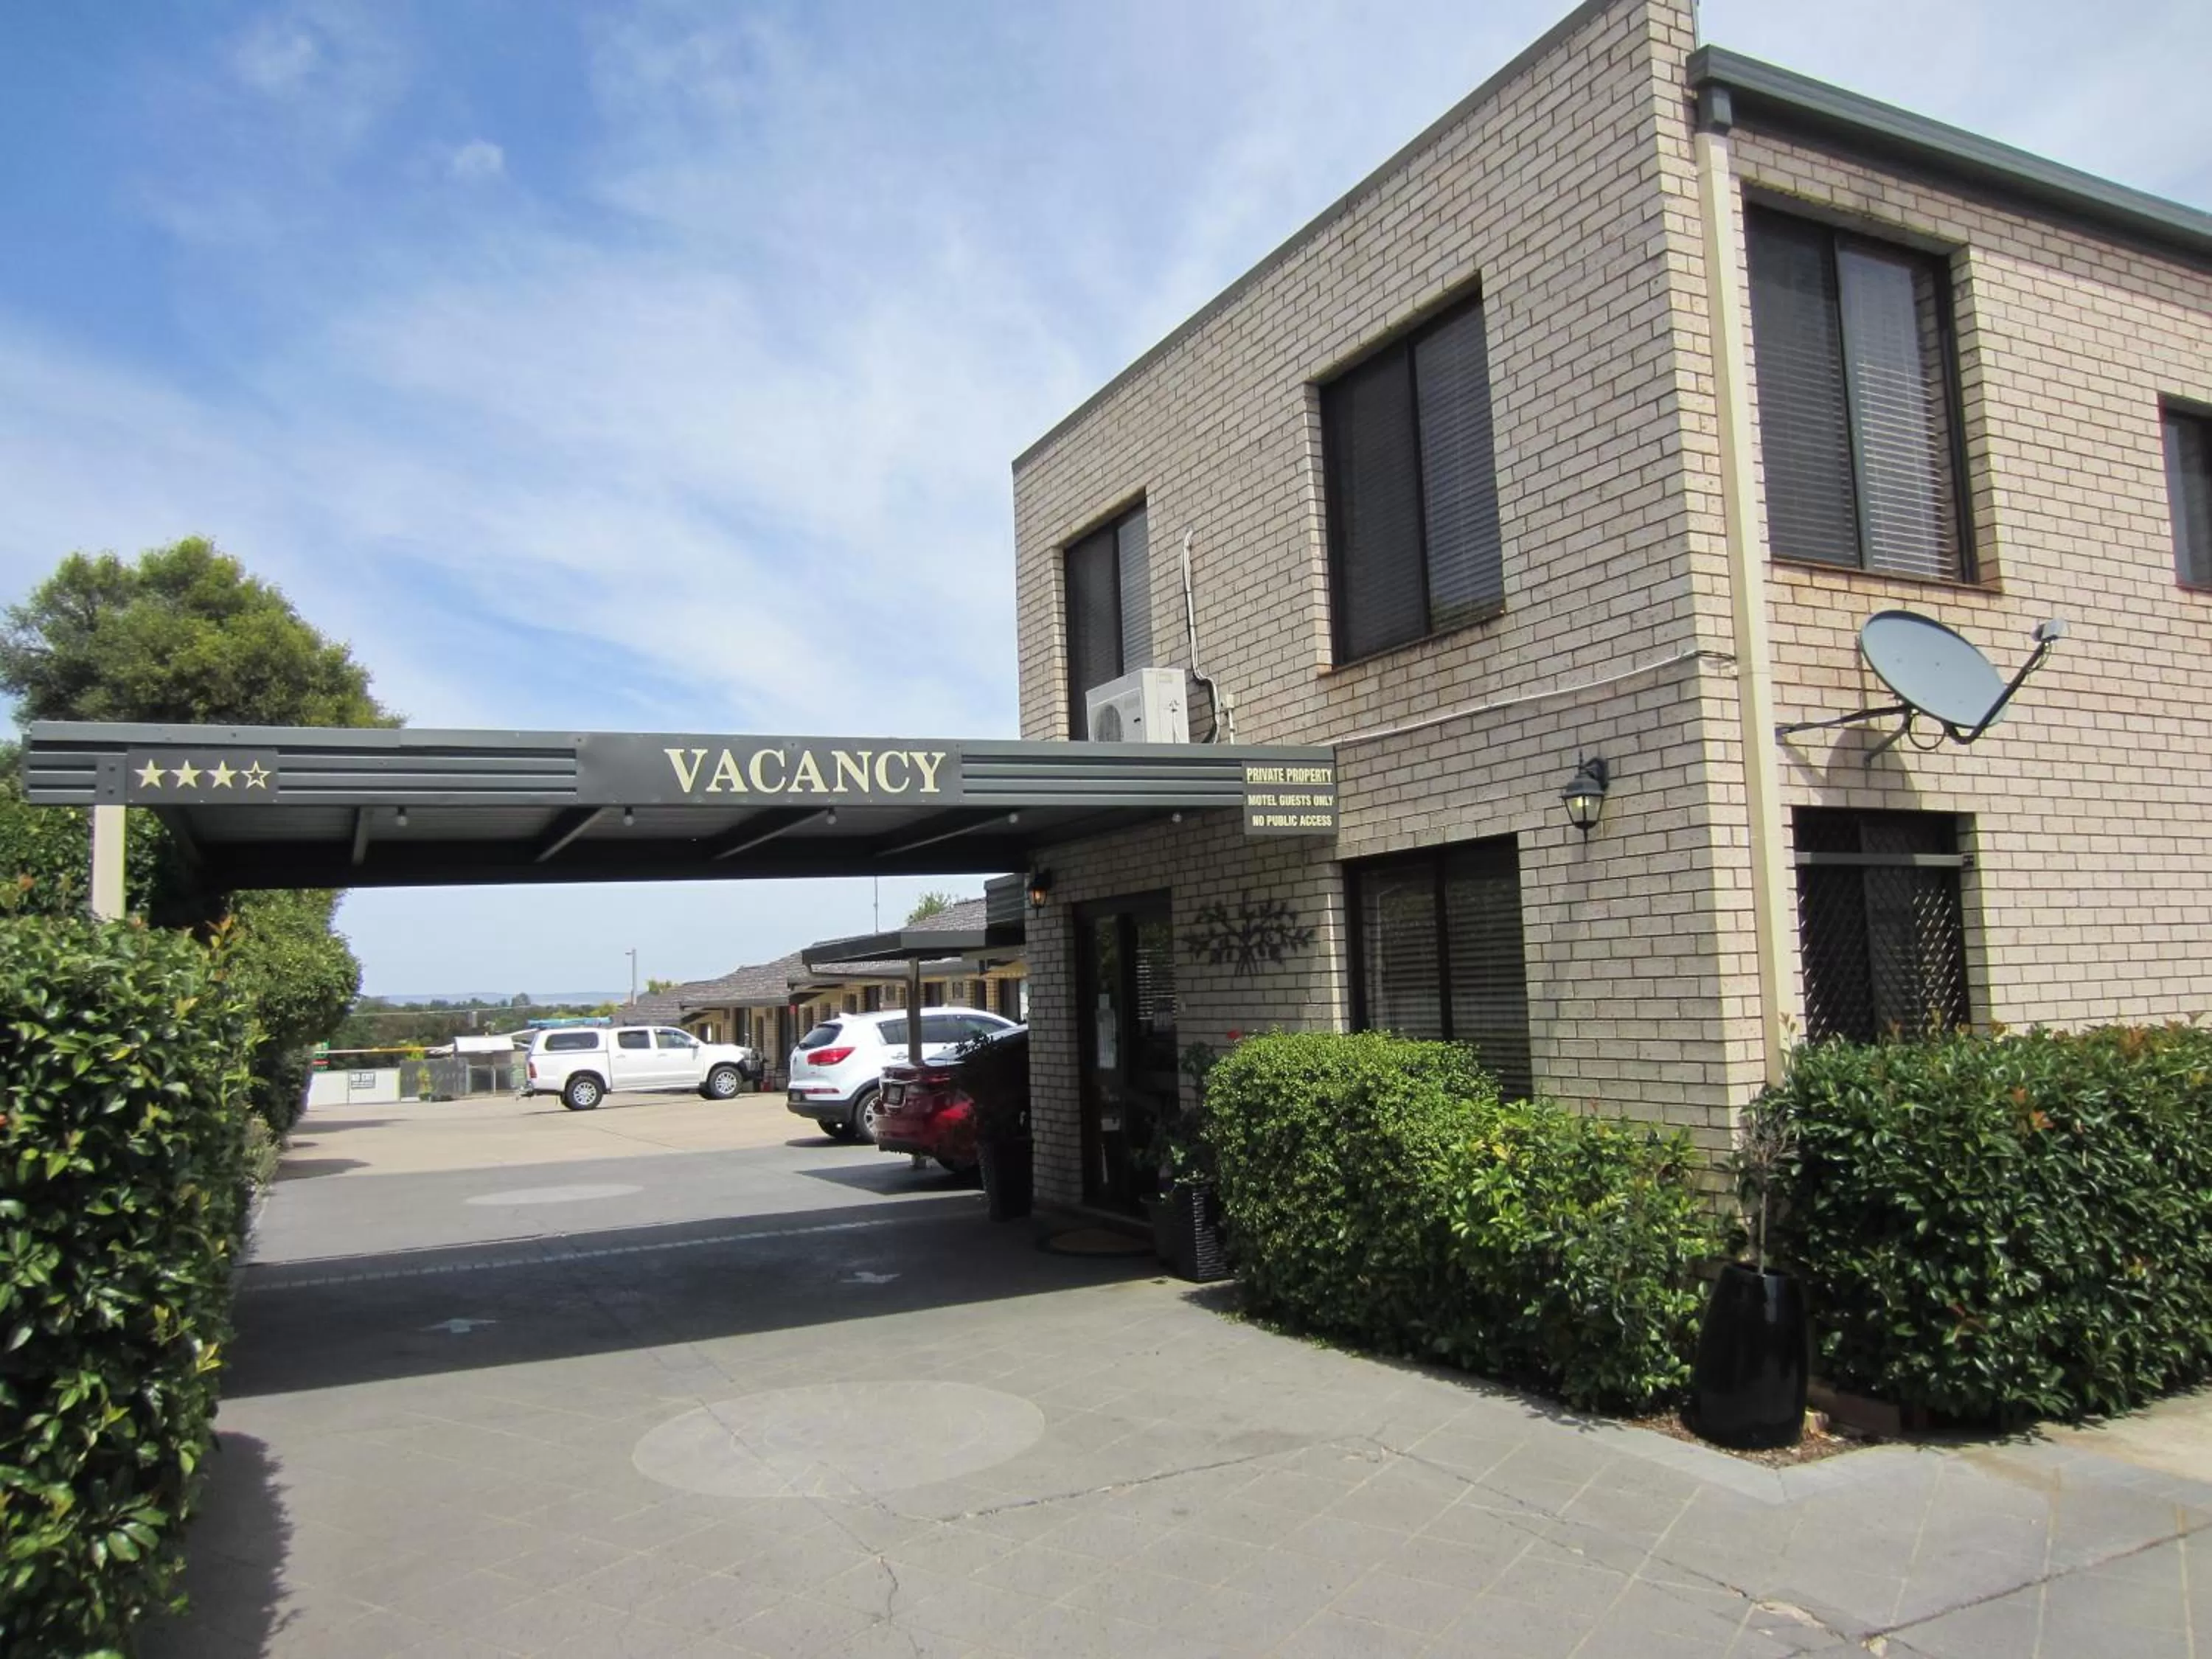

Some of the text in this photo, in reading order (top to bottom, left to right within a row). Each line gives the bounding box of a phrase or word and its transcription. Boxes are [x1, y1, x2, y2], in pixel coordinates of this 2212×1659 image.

[664, 748, 946, 793] VACANCY
[1246, 767, 1332, 782] PRIVATE PROPERTY
[1248, 794, 1334, 806] MOTEL GUESTS ONLY
[1252, 815, 1332, 827] NO PUBLIC ACCESS
